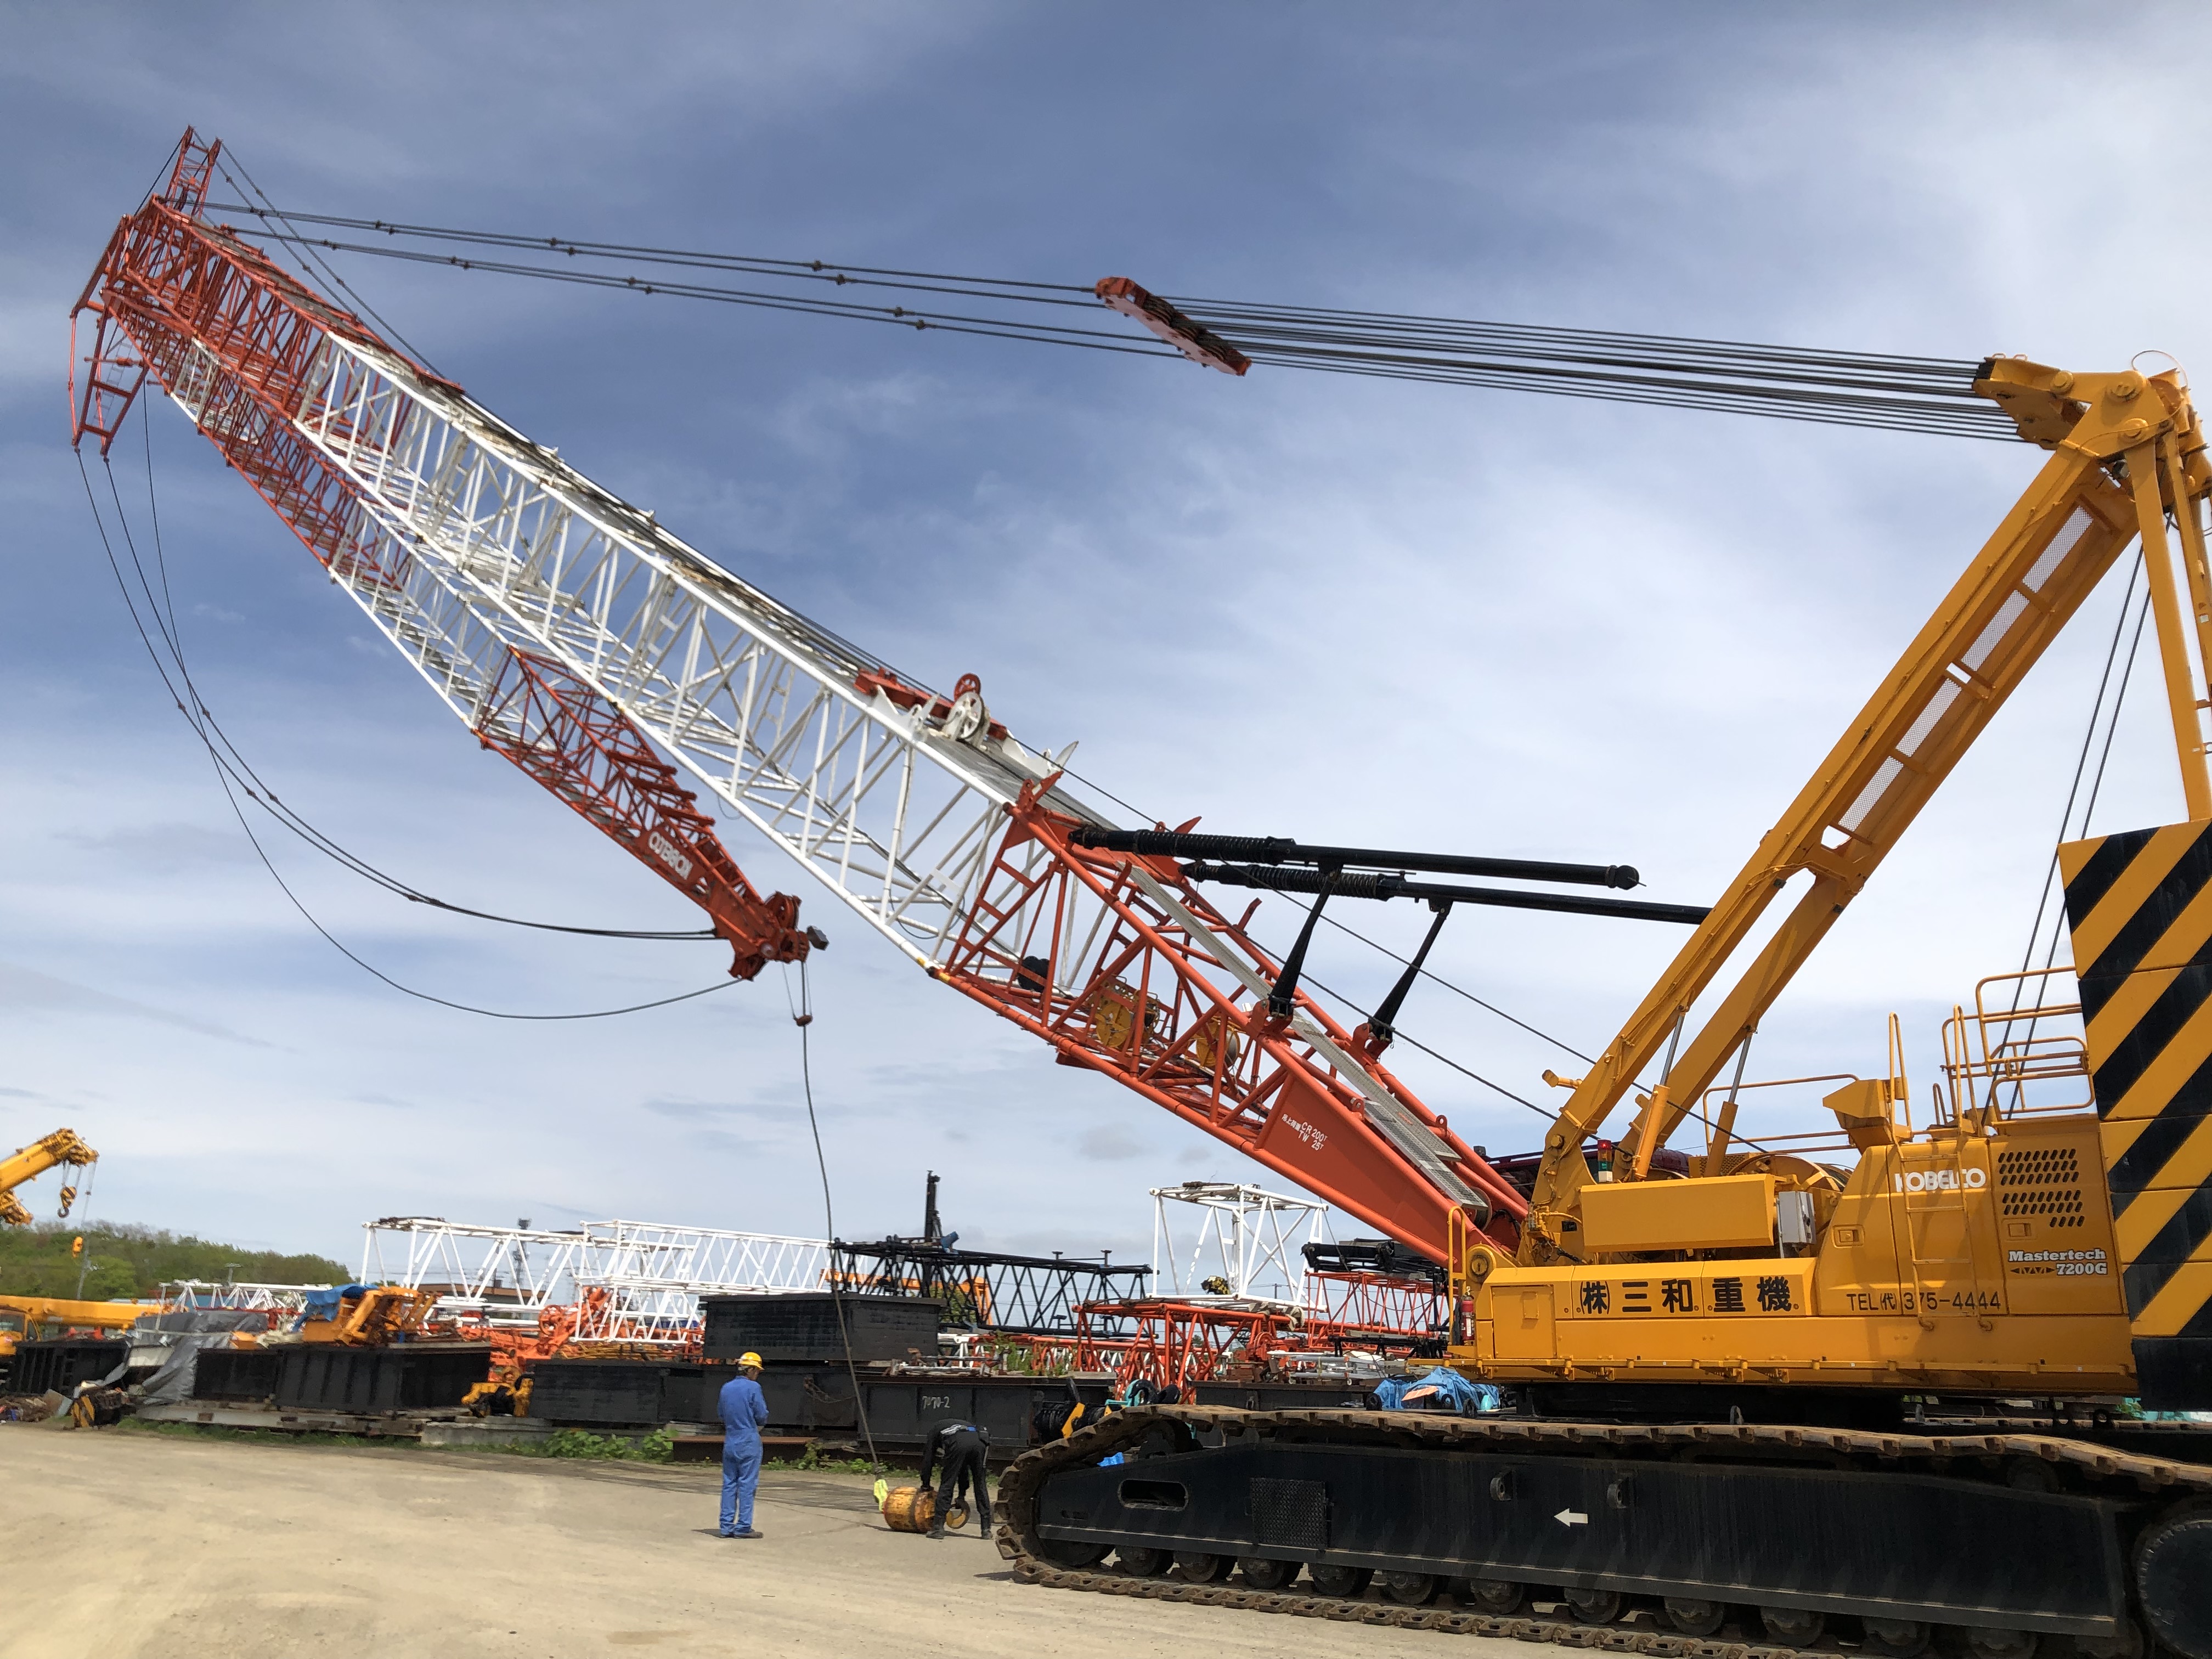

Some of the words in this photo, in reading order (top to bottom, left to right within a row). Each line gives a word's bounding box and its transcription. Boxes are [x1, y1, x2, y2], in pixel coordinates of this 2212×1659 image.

[1301, 1121, 1313, 1135] CR
[1298, 1130, 1310, 1143] TW
[2008, 1248, 2107, 1262] Mastertech
[2056, 1262, 2108, 1276] 7200G
